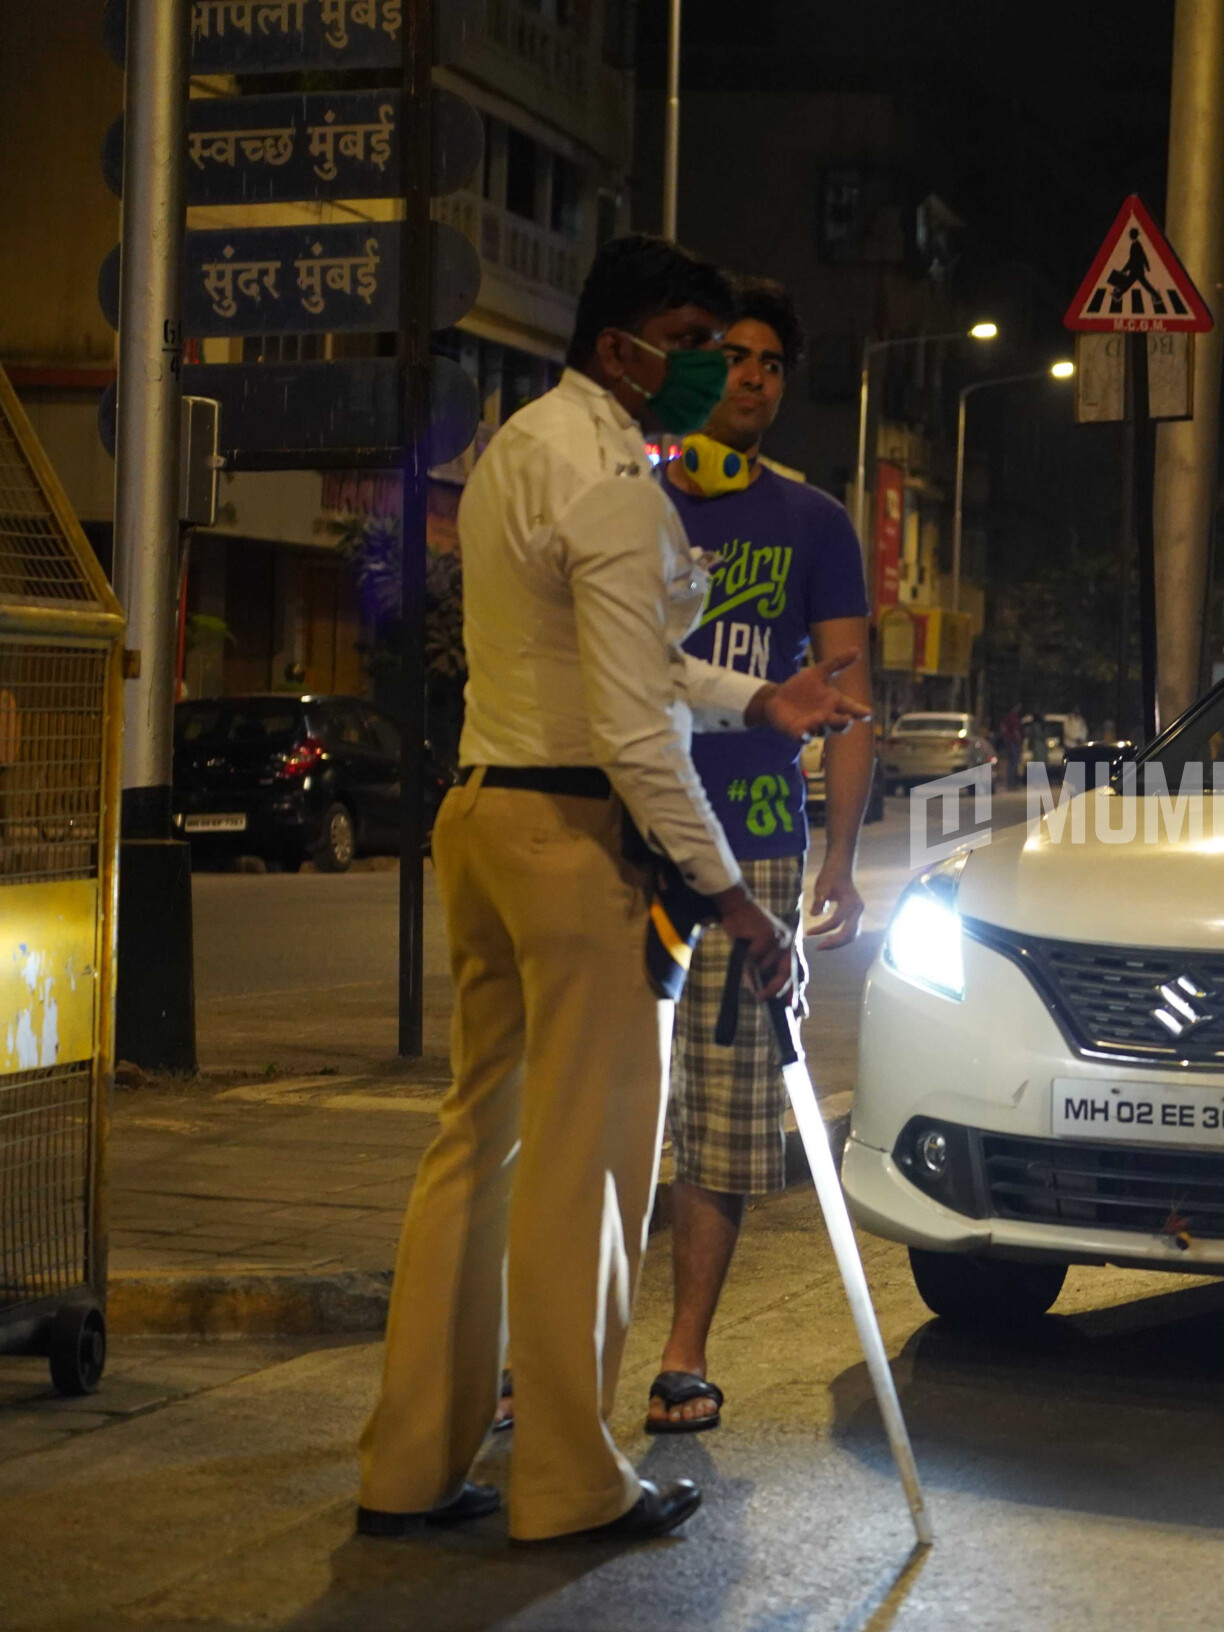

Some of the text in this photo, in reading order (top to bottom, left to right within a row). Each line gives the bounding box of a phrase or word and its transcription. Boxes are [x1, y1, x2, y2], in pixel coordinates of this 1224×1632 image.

[189, 104, 395, 181] स्वच्छ मुंबई
[202, 237, 380, 318] सुंदर मुंबई
[1064, 1098, 1109, 1121] MH
[1116, 1101, 1153, 1124] 02
[1161, 1104, 1195, 1127] EE
